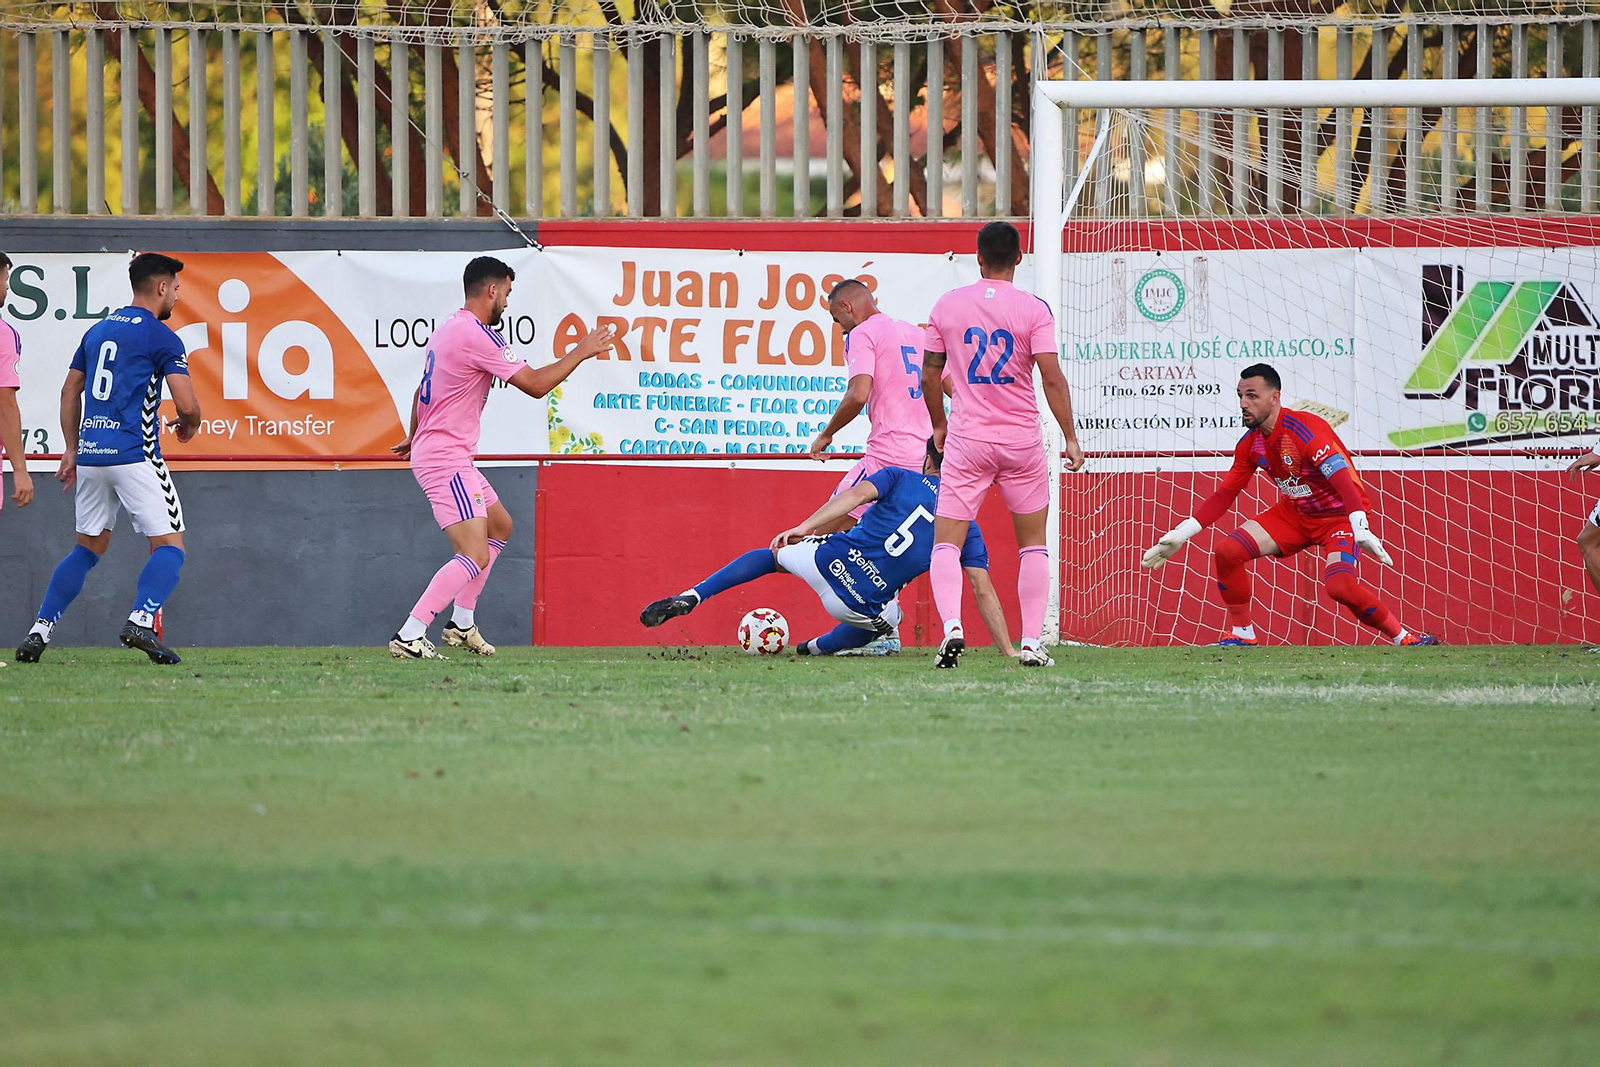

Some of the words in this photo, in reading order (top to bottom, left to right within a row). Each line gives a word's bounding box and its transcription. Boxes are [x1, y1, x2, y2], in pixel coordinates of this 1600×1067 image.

[7, 265, 123, 321] S.L
[612, 261, 738, 308] Juan
[553, 313, 700, 362] ARTE
[1075, 342, 1174, 360] MADERERA
[1180, 336, 1221, 363] JOSÉ
[1226, 338, 1330, 360] CARRASCO,
[963, 326, 1015, 385] 22
[91, 340, 118, 401] 6
[419, 349, 435, 405] 8
[639, 372, 702, 389] BODAS
[720, 374, 847, 392] COMUNIONES
[901, 345, 923, 399] 5
[1119, 366, 1197, 381] CARTAYA
[593, 393, 641, 410] ARTE
[646, 392, 732, 413] FÚNEBRE
[750, 398, 798, 414] FLOR
[1101, 385, 1137, 396] Tfno.
[1141, 385, 1165, 396] 626
[1169, 384, 1193, 395] 570
[1197, 384, 1221, 395] 893
[83, 418, 120, 429] eiman
[161, 415, 238, 440] Mney
[244, 414, 335, 436] Transfer
[655, 417, 674, 434] C-
[679, 418, 718, 434] SAN
[724, 420, 791, 437] PEDRO,
[1075, 415, 1171, 430] ABRICACIÓN
[1176, 417, 1195, 428] DE
[1496, 412, 1538, 433] 657
[1545, 411, 1588, 432] 654
[620, 439, 707, 455] CARTAYA
[726, 442, 742, 454] M
[884, 504, 935, 557] 5
